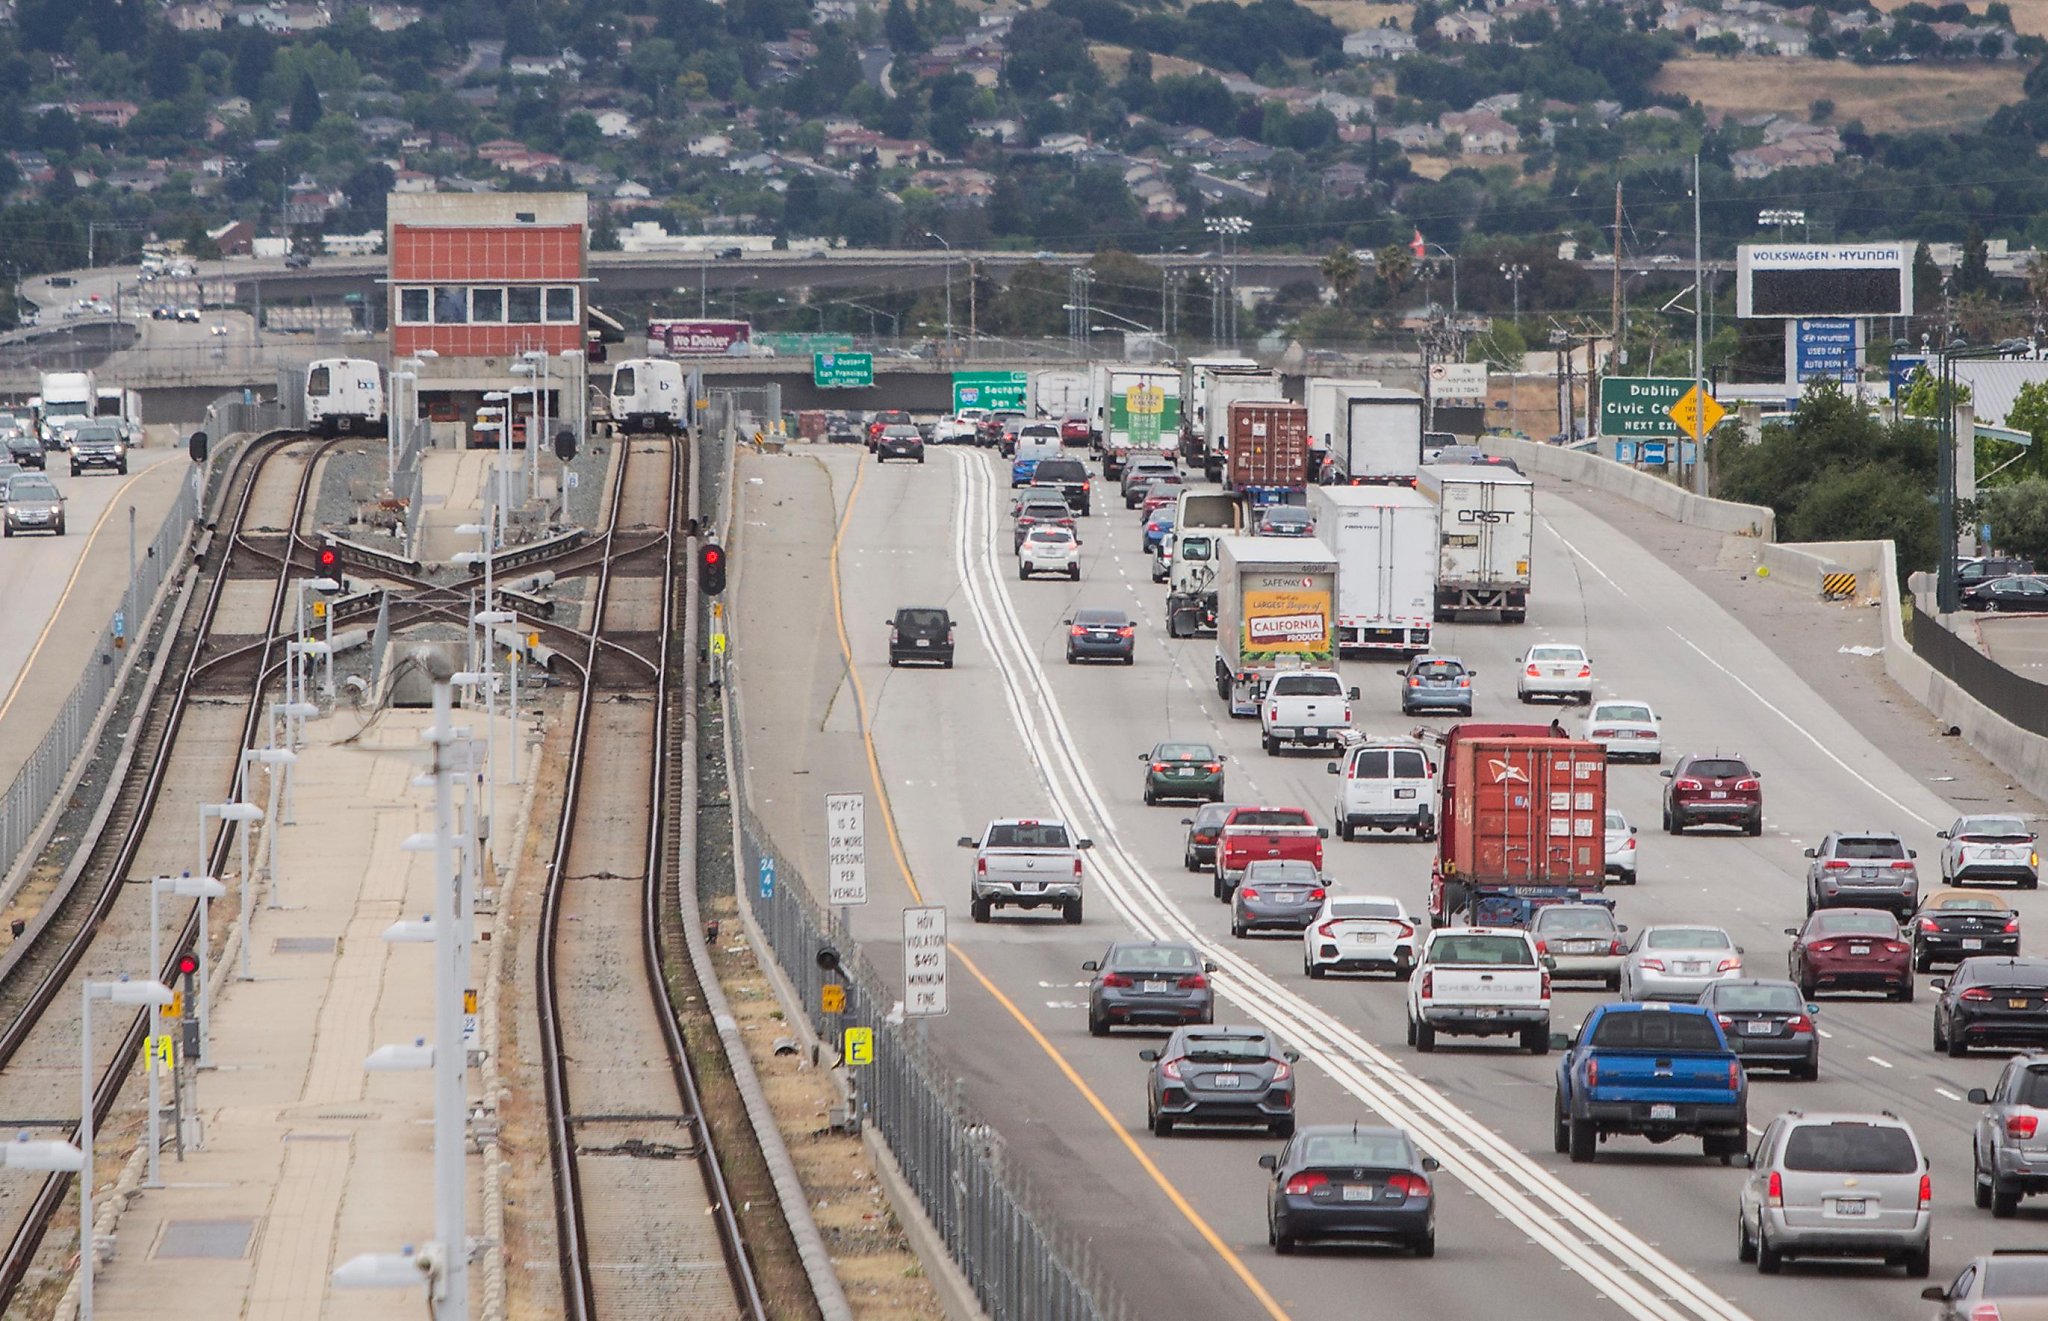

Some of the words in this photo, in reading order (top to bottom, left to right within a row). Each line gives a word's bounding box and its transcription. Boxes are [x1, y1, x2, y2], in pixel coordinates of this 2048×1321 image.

[1753, 251, 1829, 261] VOLKSWAGEN
[1839, 250, 1899, 260] HYUNDAI
[690, 334, 730, 346] Deliver
[1807, 347, 1826, 355] USED
[1804, 360, 1823, 368] AUTO
[1824, 360, 1848, 368] REPAR
[984, 385, 1027, 394] Sacram
[1630, 385, 1679, 396] Dublin
[1607, 402, 1645, 414] Civic
[1651, 403, 1673, 415] Ce
[1624, 421, 1654, 431] NEXT
[1658, 422, 1677, 431] EXI
[1458, 509, 1515, 524] CRST
[1262, 578, 1301, 587] SAFEWAY
[1254, 619, 1320, 632] CALIFORNIA
[1287, 632, 1323, 642] PRODUCE
[830, 801, 848, 811] HOV
[850, 817, 856, 830] 2
[831, 837, 841, 847] OR
[844, 836, 863, 847] MORE
[760, 858, 774, 870] 24
[830, 853, 864, 864] PERSONS
[764, 873, 771, 885] 4
[841, 870, 855, 881] PER
[832, 887, 864, 898] VEHICLE
[917, 917, 934, 929] HOV
[908, 934, 945, 948] VIOLATION
[908, 973, 945, 986] MINIMUM
[1438, 984, 1536, 992] CHEVROLET
[917, 992, 936, 1005] FINE
[852, 1042, 867, 1061] E
